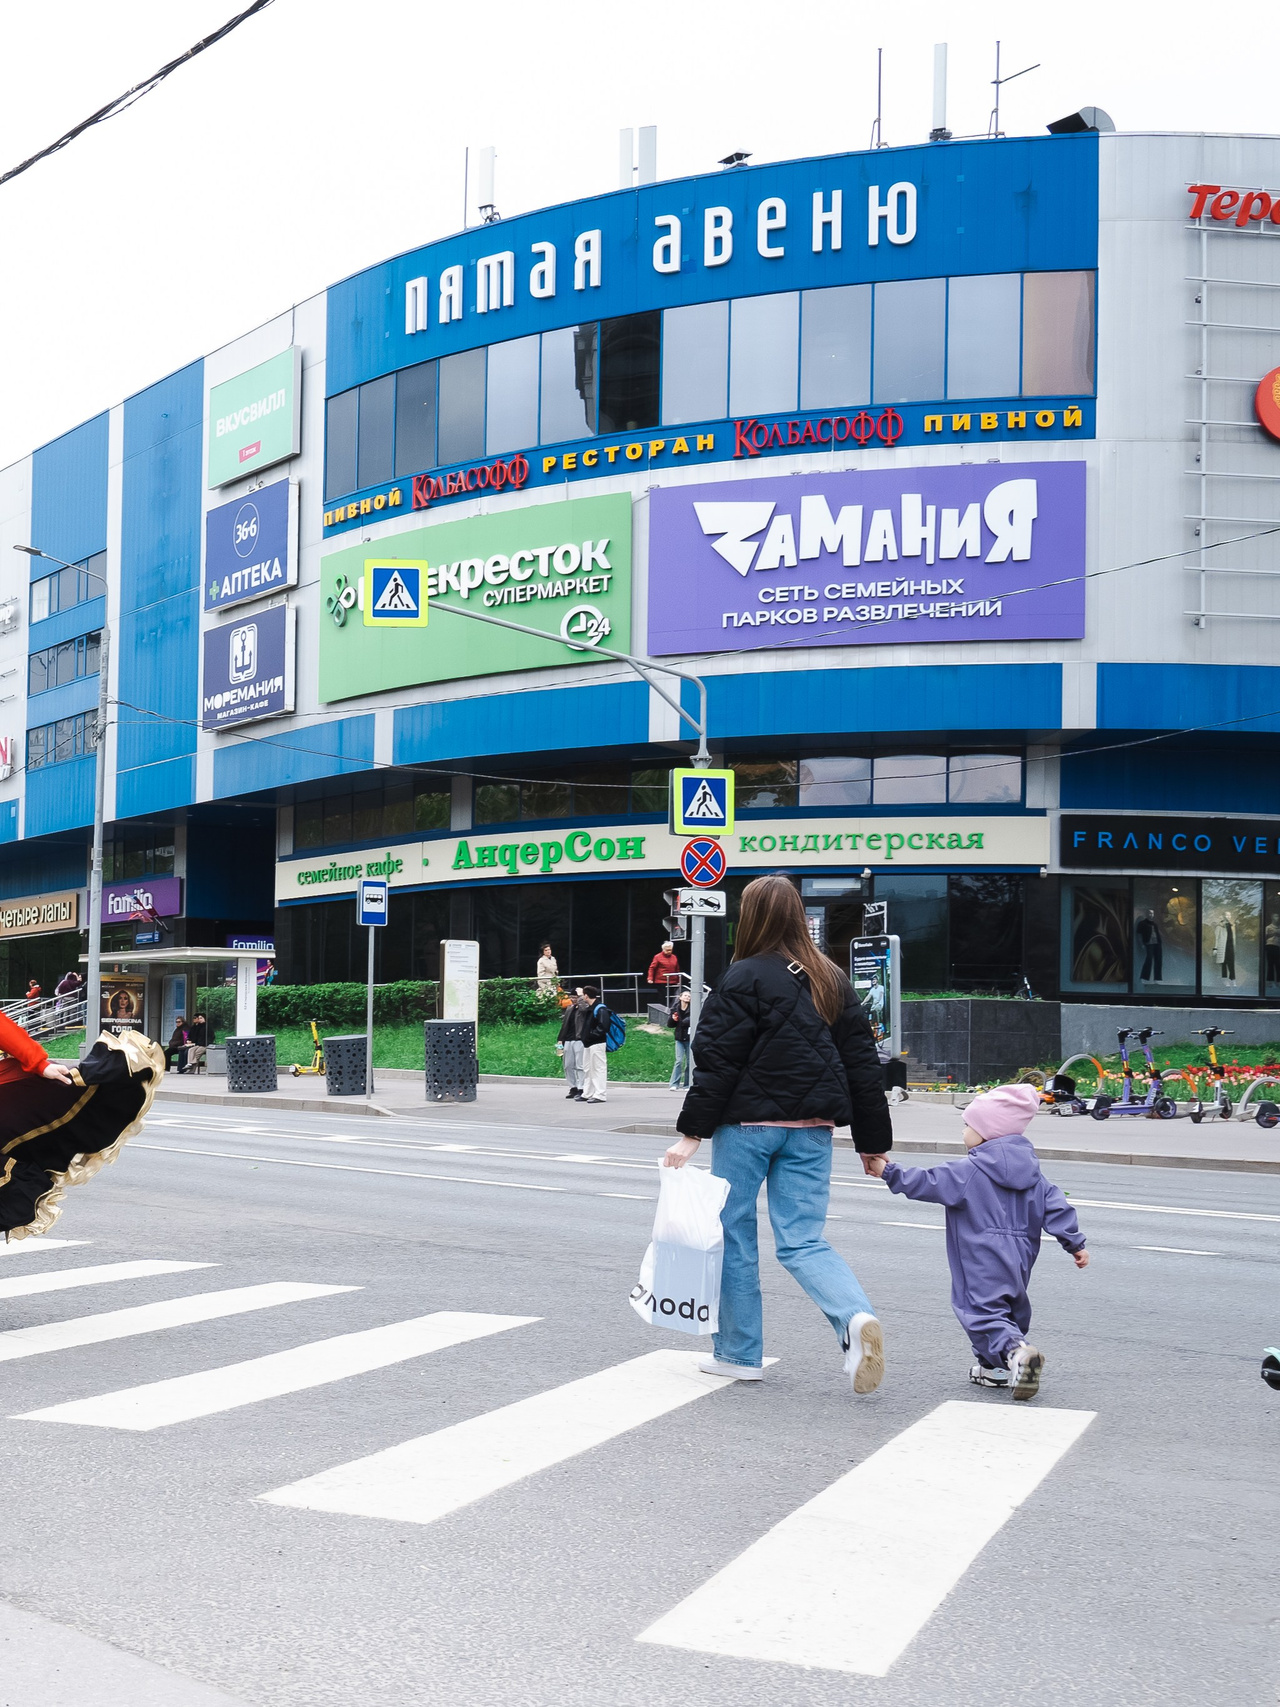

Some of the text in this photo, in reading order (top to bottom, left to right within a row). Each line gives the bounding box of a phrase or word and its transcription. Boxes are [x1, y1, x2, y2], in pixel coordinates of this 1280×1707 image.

[216, 388, 286, 437] ВКУСВИЛЛ
[323, 487, 401, 527] ПИВНОЙ
[542, 433, 715, 473] РЕСТОРАН
[924, 406, 1083, 433] ПИВНОЙ
[220, 557, 282, 598] АПТЕКА
[483, 575, 612, 608] СУПЕРМАРКЕТ
[758, 577, 965, 604] СЕТЬ СЕМЕЙНЫХ
[587, 617, 612, 637] 24
[721, 599, 1003, 629] ПАРКОВ РАЗВЛЕЧЕНИЙ
[204, 676, 283, 712] МОРЕМАНИЯ
[216, 700, 269, 719] МАГАЗИН-КАФЕ
[297, 831, 985, 886] семейное кафе АндерСон кондитерская
[1073, 831, 1280, 854] FRANCO VE
